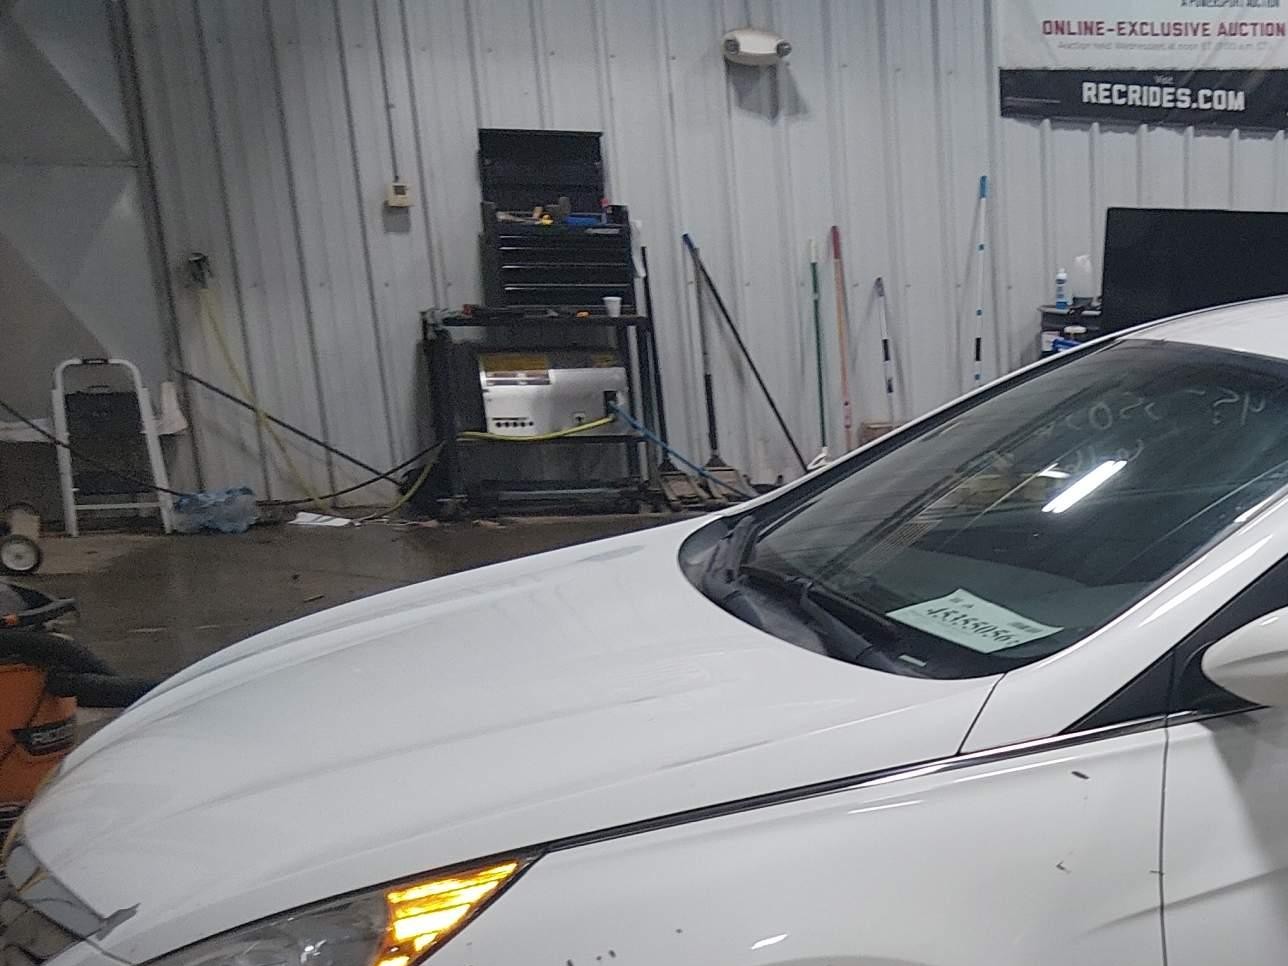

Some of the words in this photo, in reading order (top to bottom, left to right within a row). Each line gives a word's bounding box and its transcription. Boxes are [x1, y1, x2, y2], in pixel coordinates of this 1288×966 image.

[1042, 20, 1210, 37] ONLINE-EXCLUSIVE
[1216, 22, 1287, 37] AUCTION
[1081, 81, 1246, 112] RECRIDES.COM
